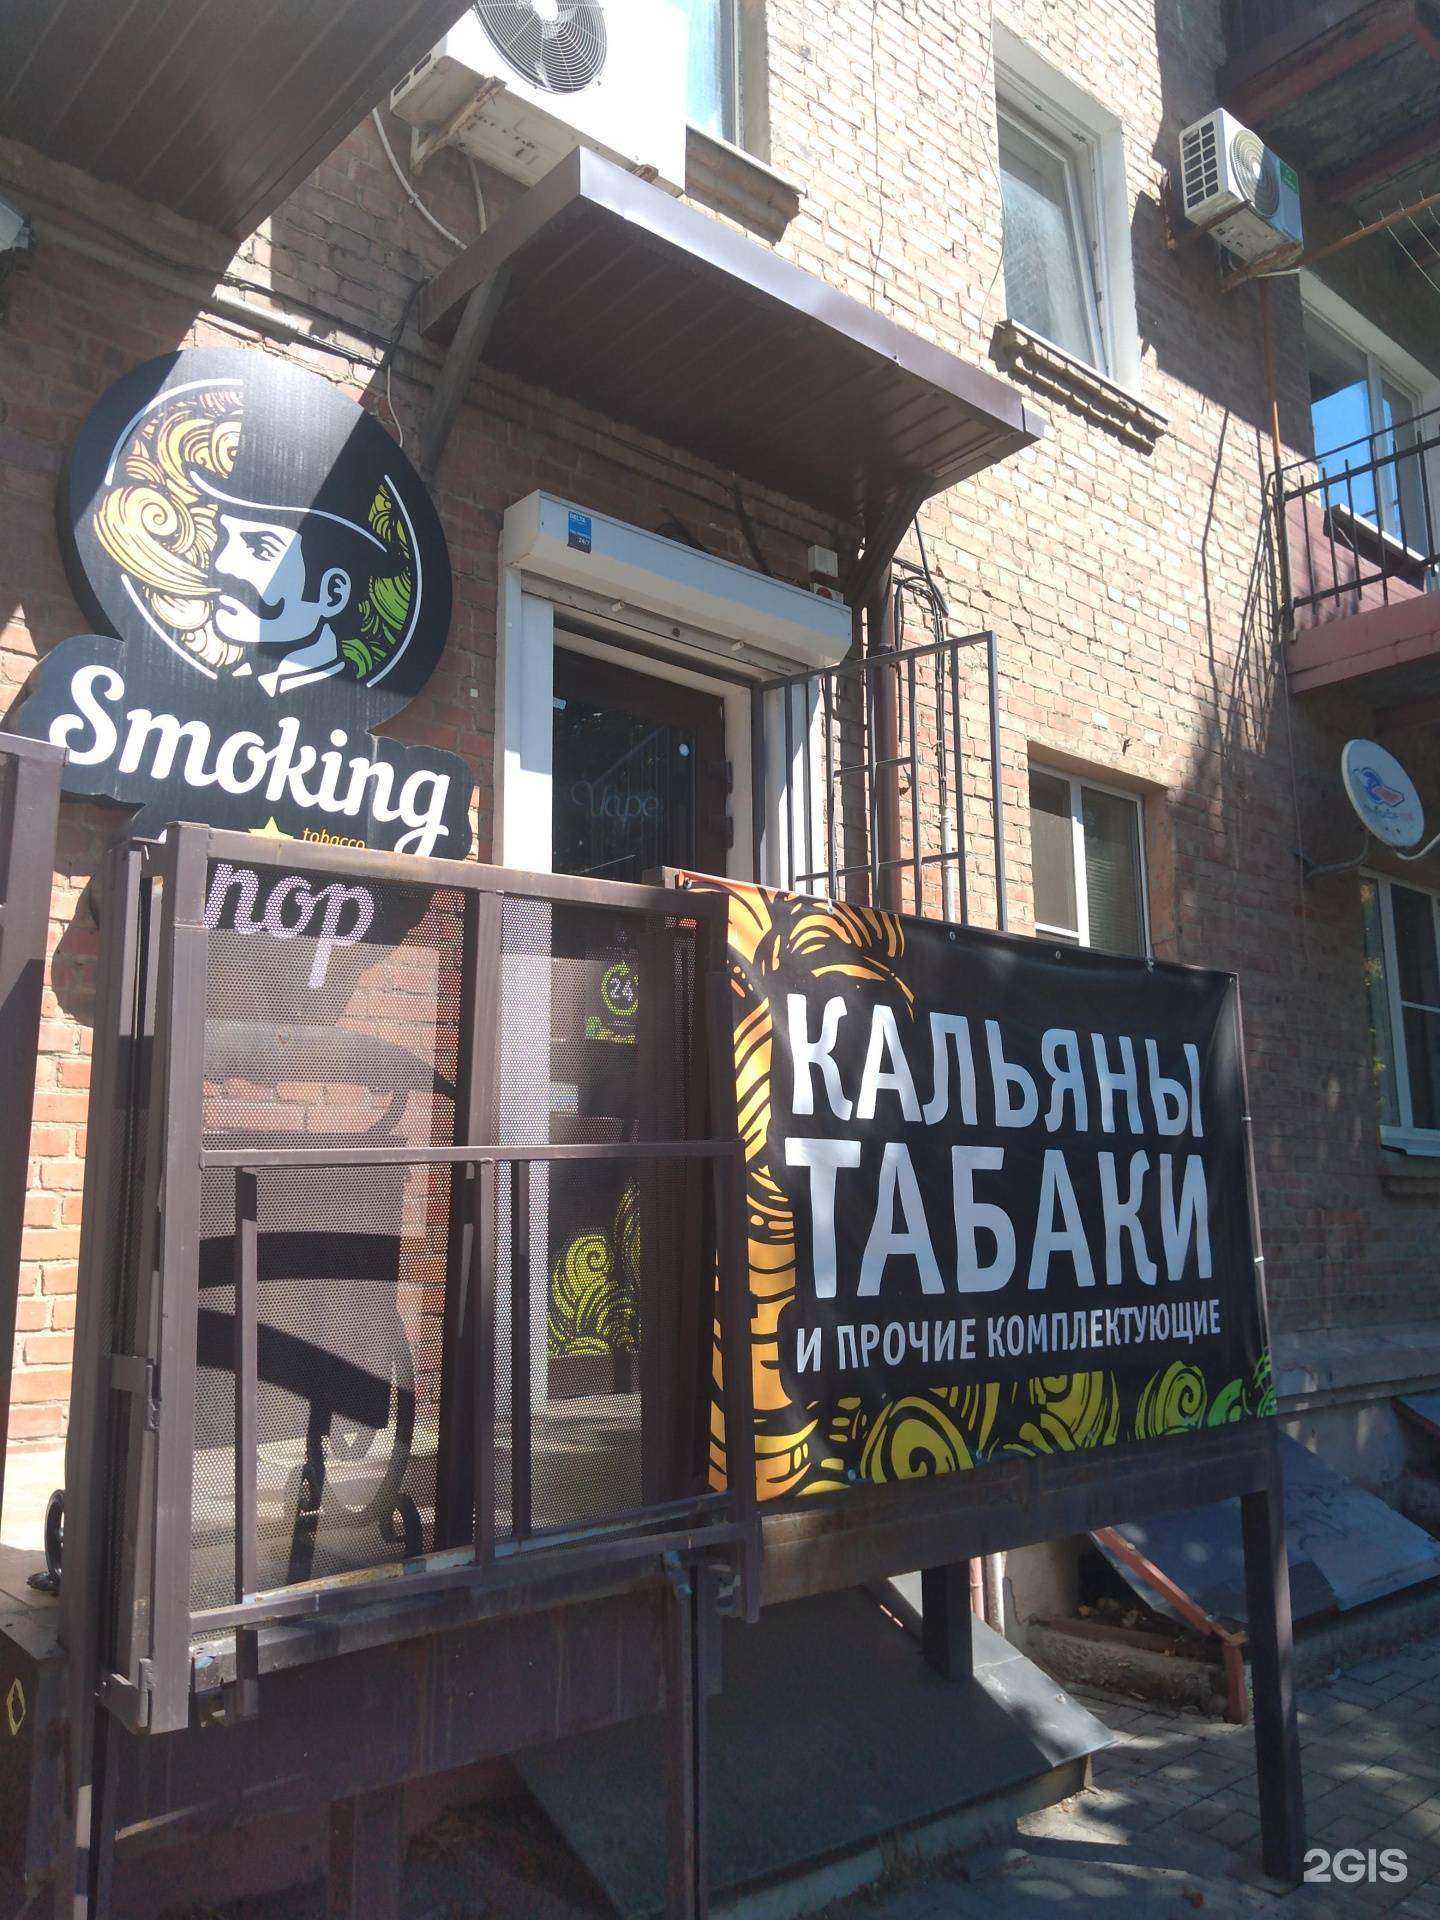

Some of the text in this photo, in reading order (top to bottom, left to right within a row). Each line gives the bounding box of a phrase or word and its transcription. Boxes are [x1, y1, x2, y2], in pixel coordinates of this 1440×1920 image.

[49, 665, 451, 857] Smoking
[786, 993, 1204, 1138] КАЛЬЯНЫ
[784, 1137, 1213, 1299] ТАБАКИ
[797, 1299, 1221, 1373] И ПРОЧИЕ КОМПЛЕКТУЮЩИЕ
